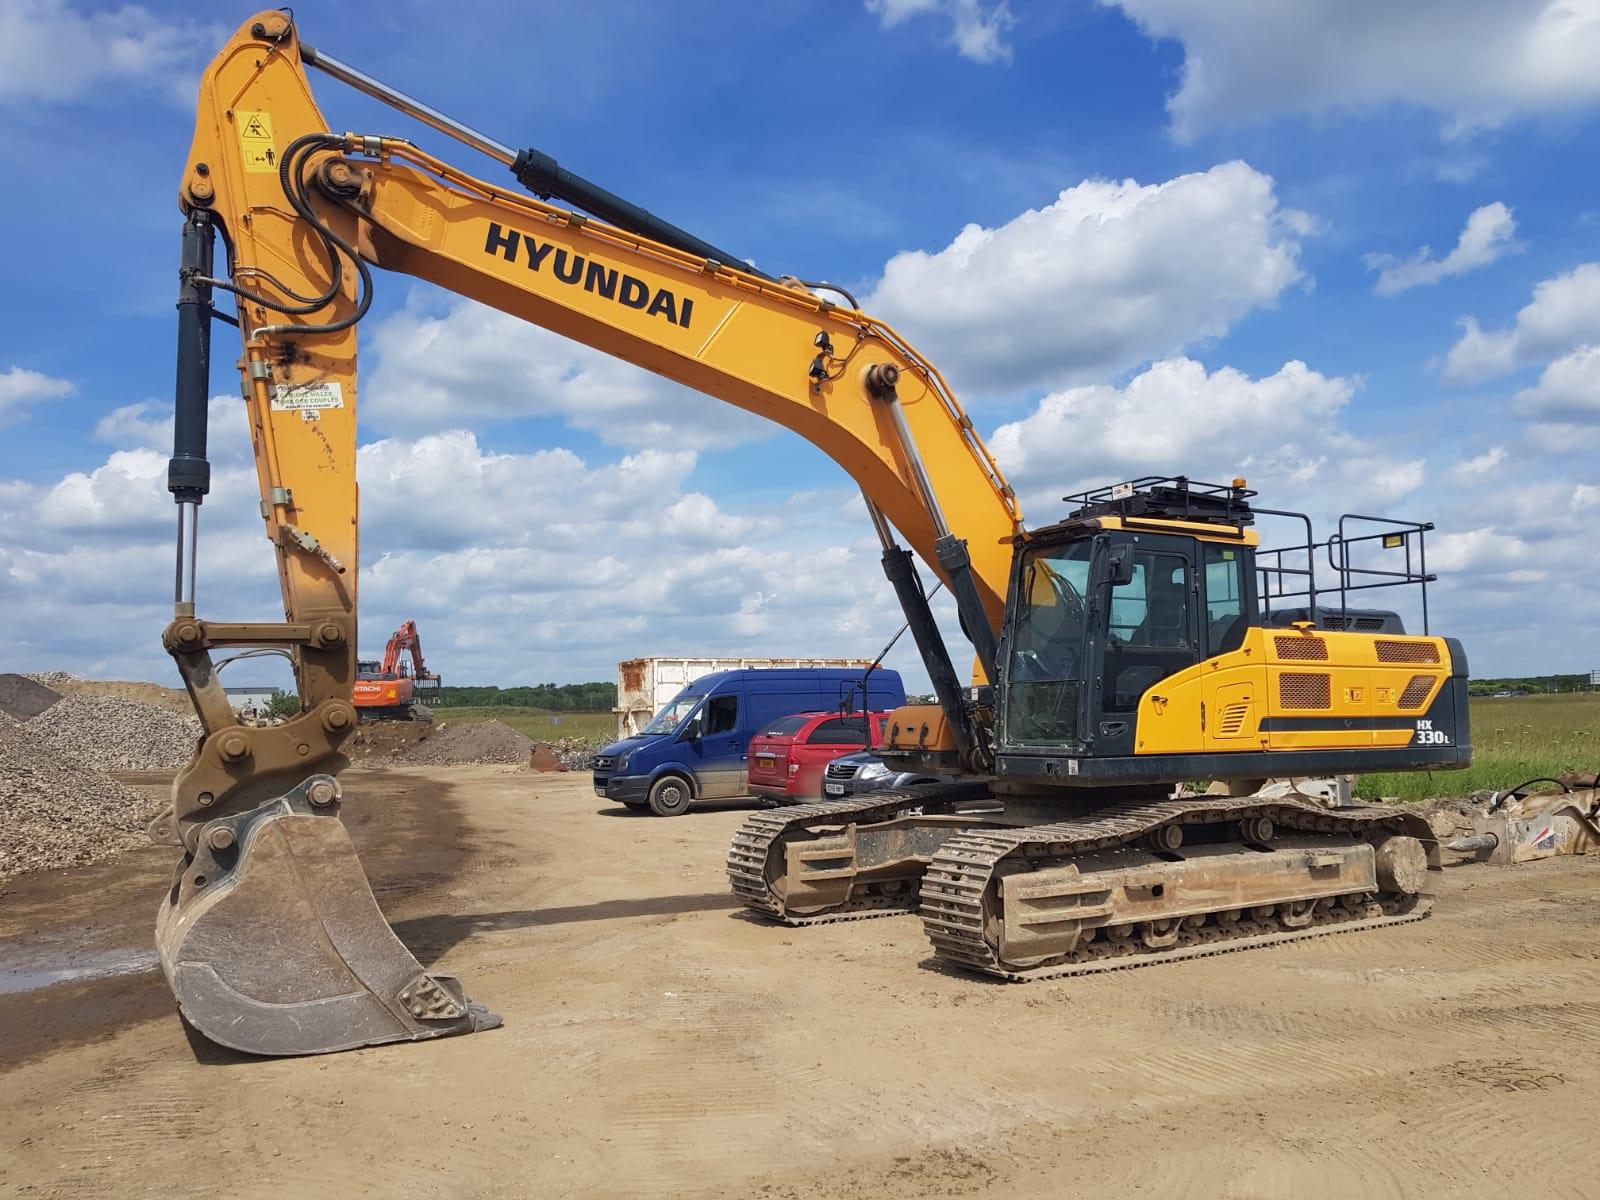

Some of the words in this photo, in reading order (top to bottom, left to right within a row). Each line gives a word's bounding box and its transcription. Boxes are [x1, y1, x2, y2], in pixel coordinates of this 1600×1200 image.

[484, 222, 694, 330] HYUNDAI
[1416, 720, 1433, 730] HX
[1416, 731, 1450, 744] 330L
